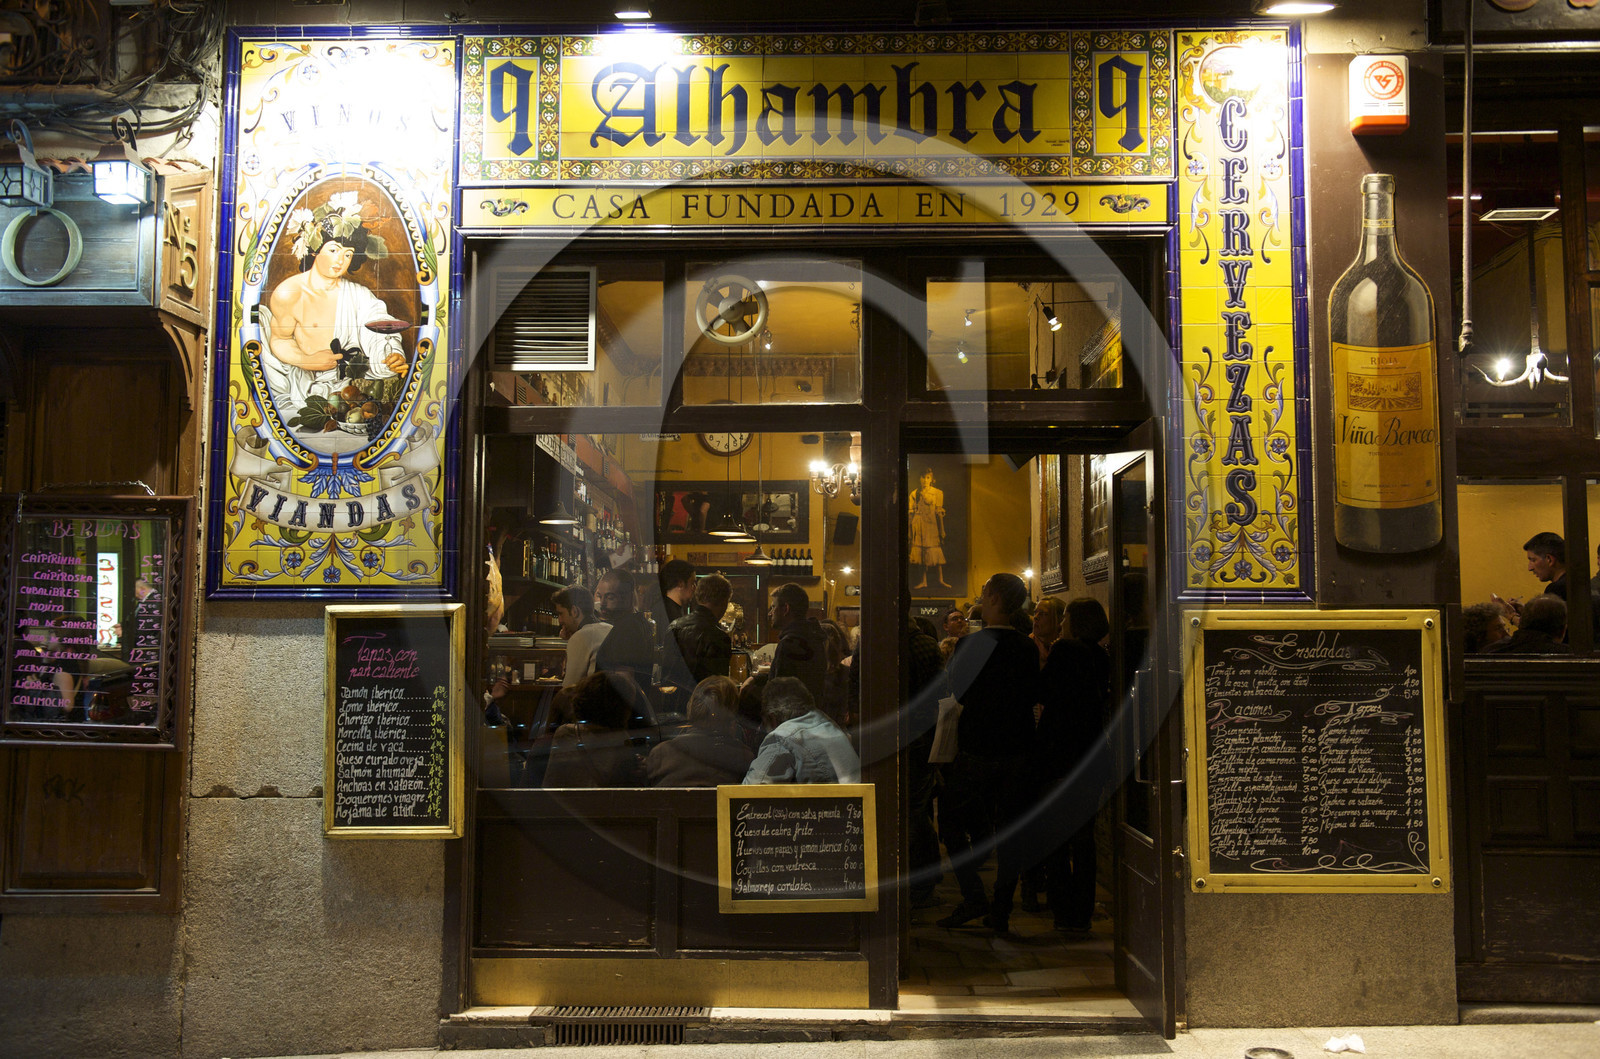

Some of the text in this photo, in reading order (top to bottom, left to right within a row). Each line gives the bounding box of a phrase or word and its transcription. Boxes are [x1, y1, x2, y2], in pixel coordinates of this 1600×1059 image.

[590, 61, 1042, 156] Alhambra
[552, 193, 651, 220] CASA
[682, 192, 884, 219] FUNDADA
[915, 191, 966, 217] EN
[180, 236, 199, 290] 5
[1217, 96, 1258, 526] CERVEZAS
[1339, 413, 1435, 446] Viña Berceo
[246, 484, 421, 529] VIANDAS
[48, 520, 143, 540] BEBIDAS
[343, 632, 419, 668] Tapas con
[1273, 631, 1352, 660] Ensaladas
[348, 661, 420, 682] pan caliente
[1205, 661, 1236, 676] Tomate
[1224, 676, 1232, 687] la
[1233, 680, 1249, 688] casa
[340, 685, 405, 699] Jamón ibérico
[338, 700, 400, 713] Lomo ibérico
[1206, 699, 1274, 722] Raciones
[337, 712, 411, 726] Chorizo ibérico
[337, 726, 407, 740] Morcilla ibérica
[336, 739, 406, 753] Cecina de vaca
[336, 752, 425, 771] Queso curado oveja
[1245, 754, 1256, 766] de
[337, 765, 416, 779] Salmón ahumado
[337, 777, 424, 792] Anchoas en salazón
[336, 792, 426, 807] Boquerones vinagre
[1260, 792, 1286, 804] salsas
[335, 803, 415, 824] Mojama de atún
[736, 803, 772, 821] Entrecot
[734, 821, 814, 841] Queso de cabra frito
[736, 839, 762, 857] Huevos
[771, 864, 785, 873] con
[734, 878, 775, 895] Salmorejo
